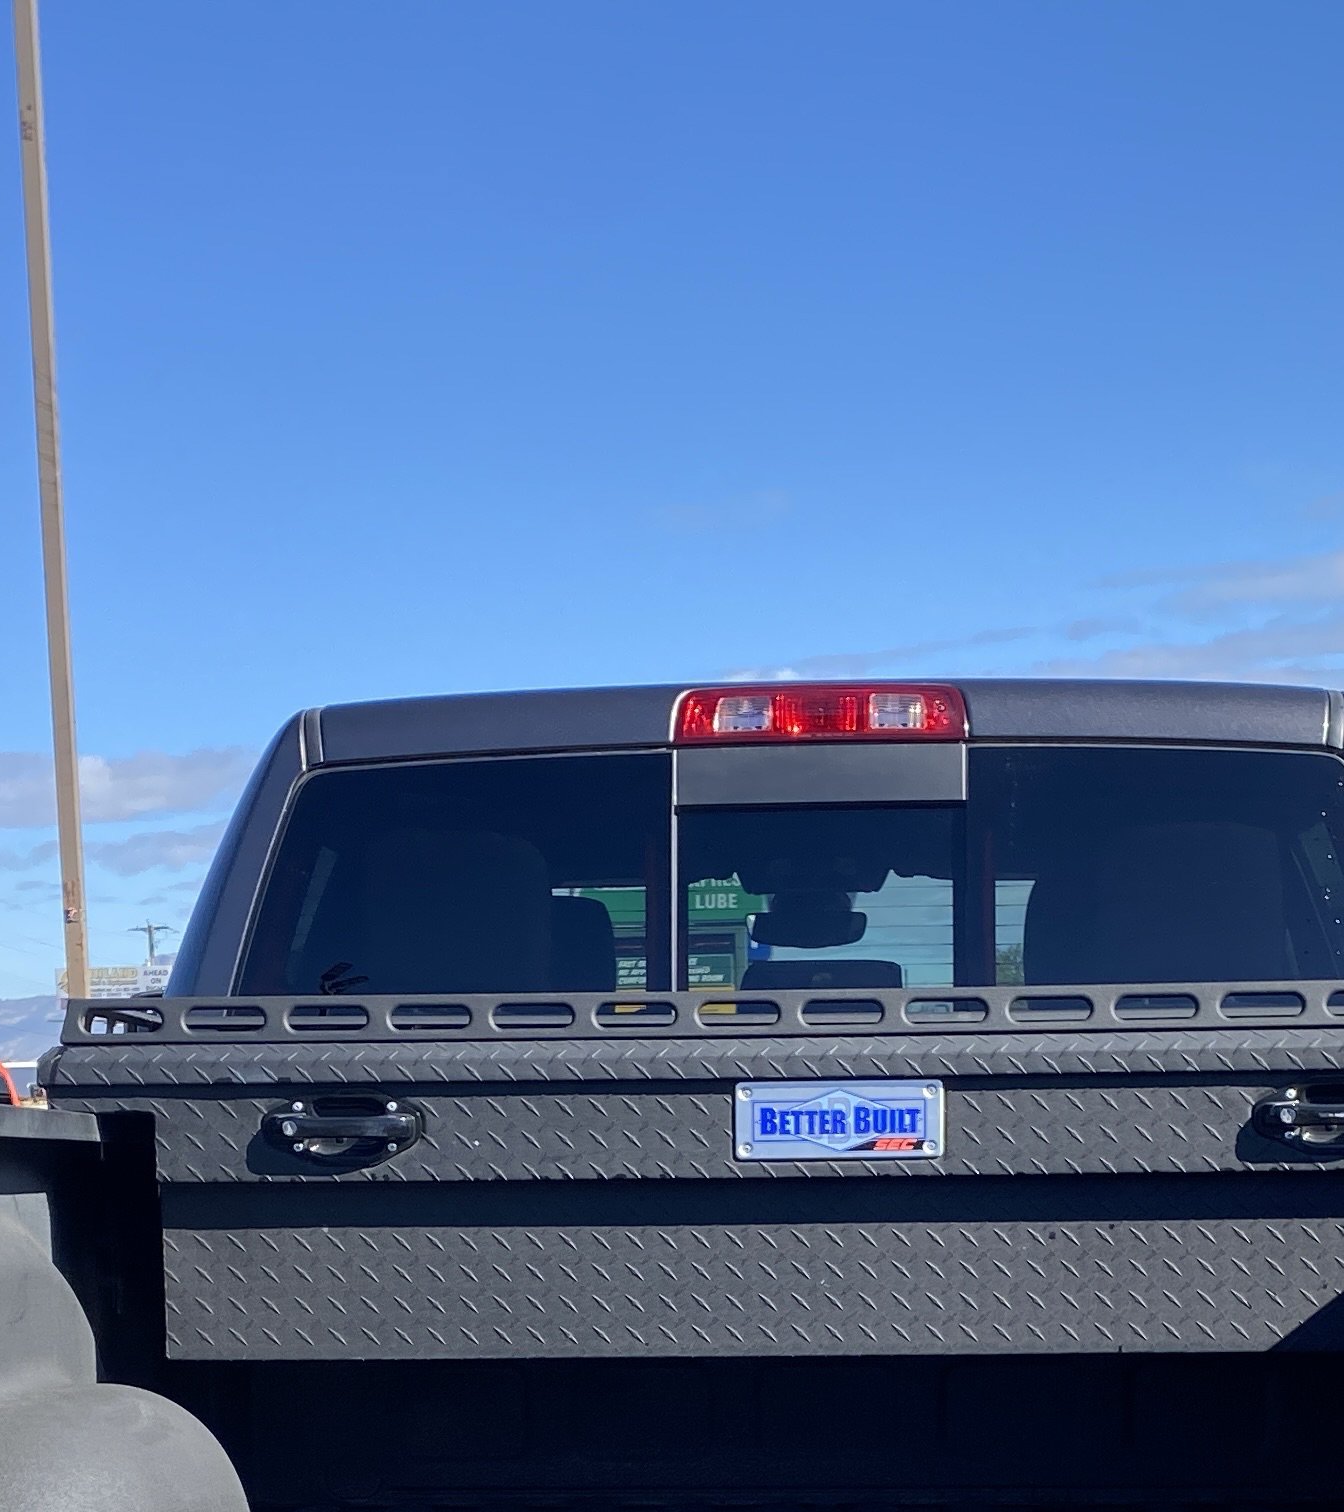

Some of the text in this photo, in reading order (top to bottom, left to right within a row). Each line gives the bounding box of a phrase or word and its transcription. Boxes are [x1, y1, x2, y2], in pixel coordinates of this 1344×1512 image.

[695, 893, 738, 909] LUBE
[143, 969, 169, 977] AHEAD
[760, 1106, 921, 1136] BETTER BUILT
[873, 1138, 918, 1151] SEC
